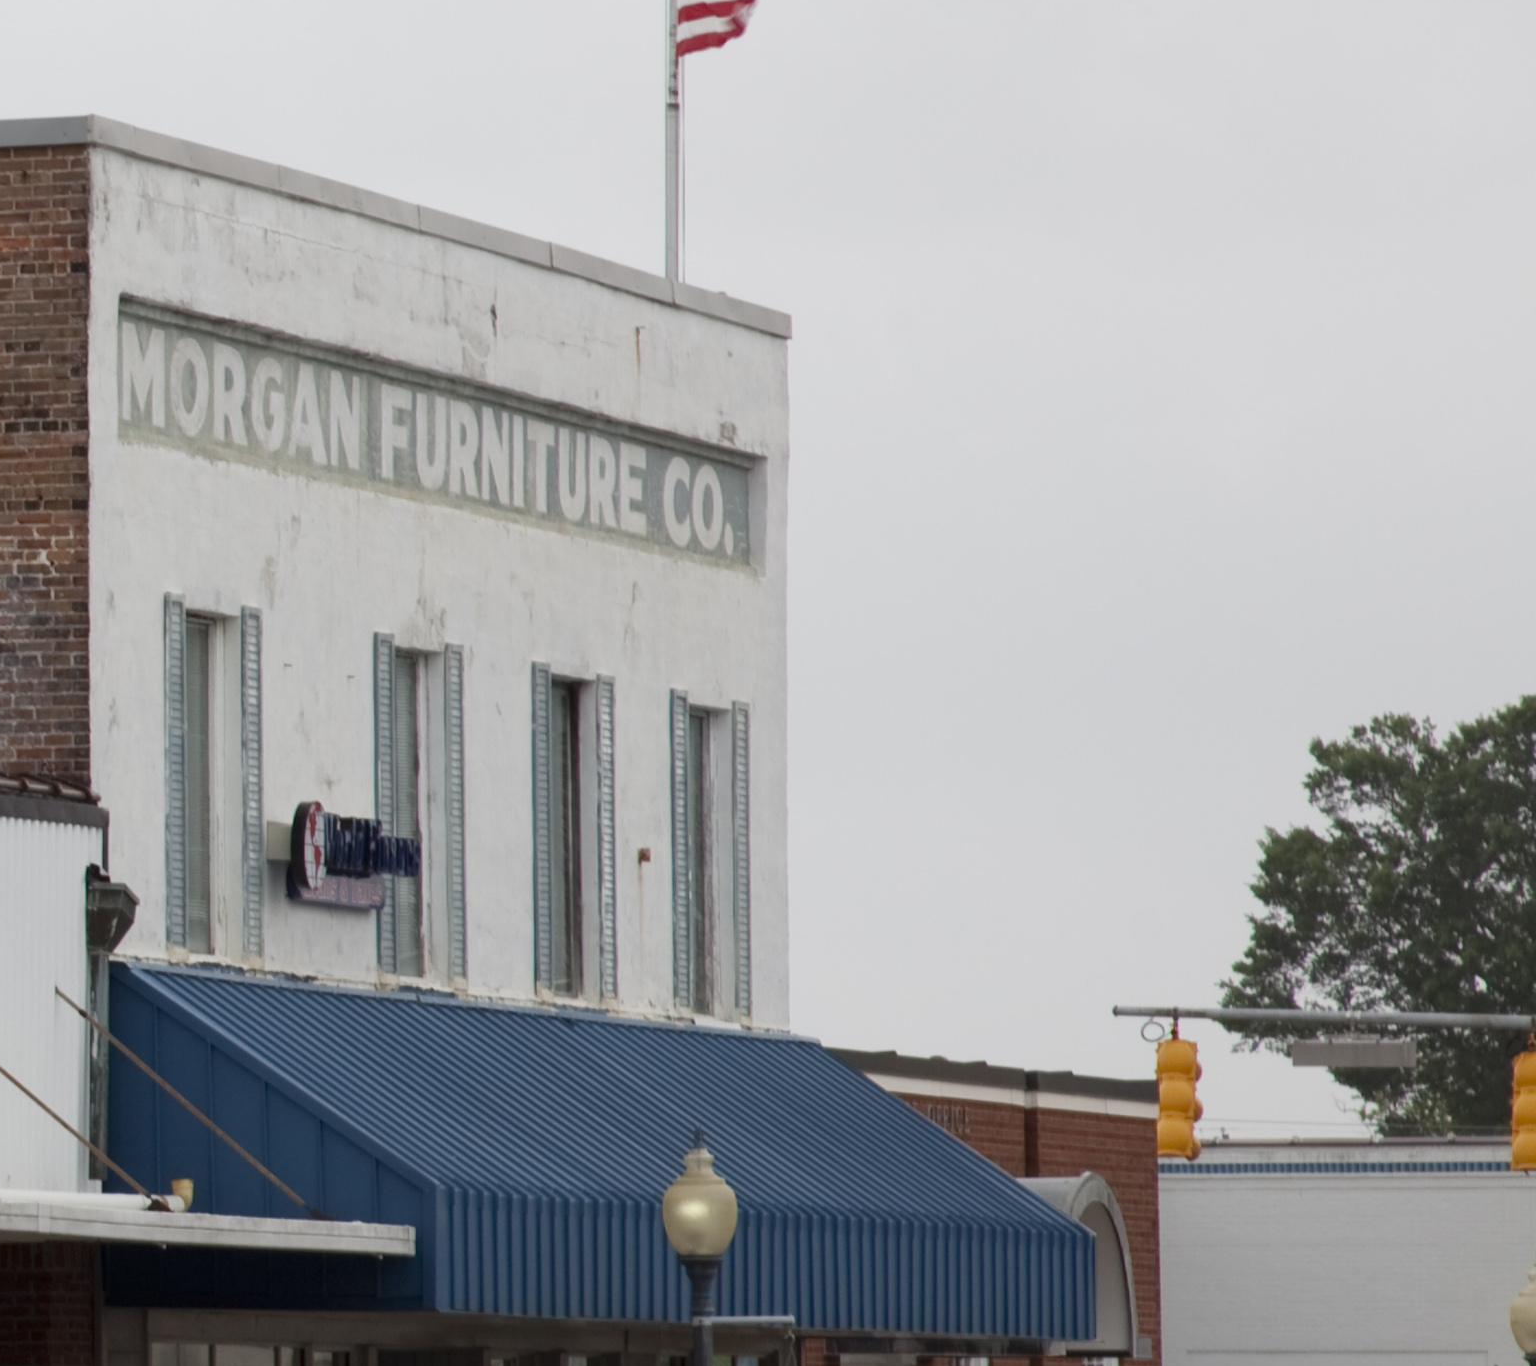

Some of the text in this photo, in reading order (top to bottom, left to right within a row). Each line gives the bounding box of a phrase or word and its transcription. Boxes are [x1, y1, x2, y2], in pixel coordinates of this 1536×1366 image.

[120, 320, 736, 557] MORGAN FURNITURE CO.
